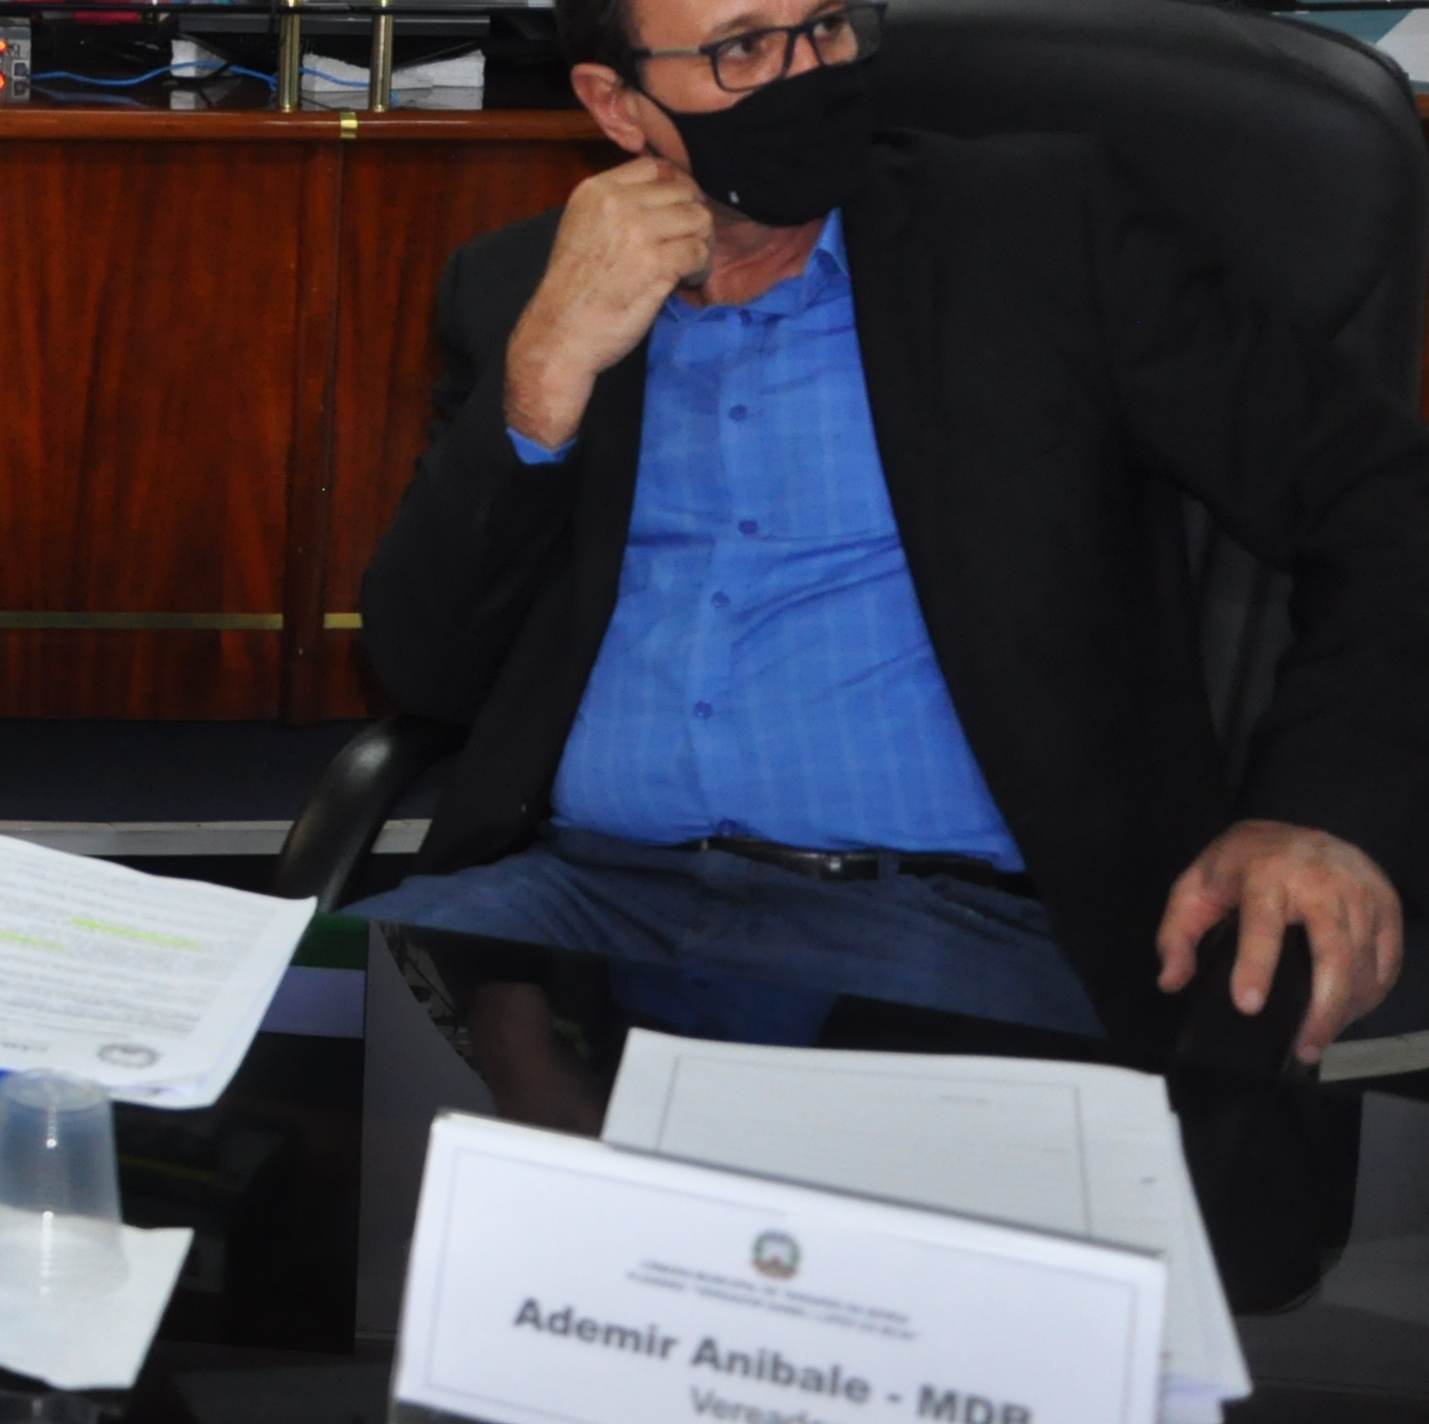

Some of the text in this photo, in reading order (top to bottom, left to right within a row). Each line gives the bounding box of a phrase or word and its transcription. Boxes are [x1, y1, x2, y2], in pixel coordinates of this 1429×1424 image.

[513, 1296, 679, 1360] Ademir
[690, 1336, 872, 1405] Anibale
[916, 1382, 1033, 1424] MDB
